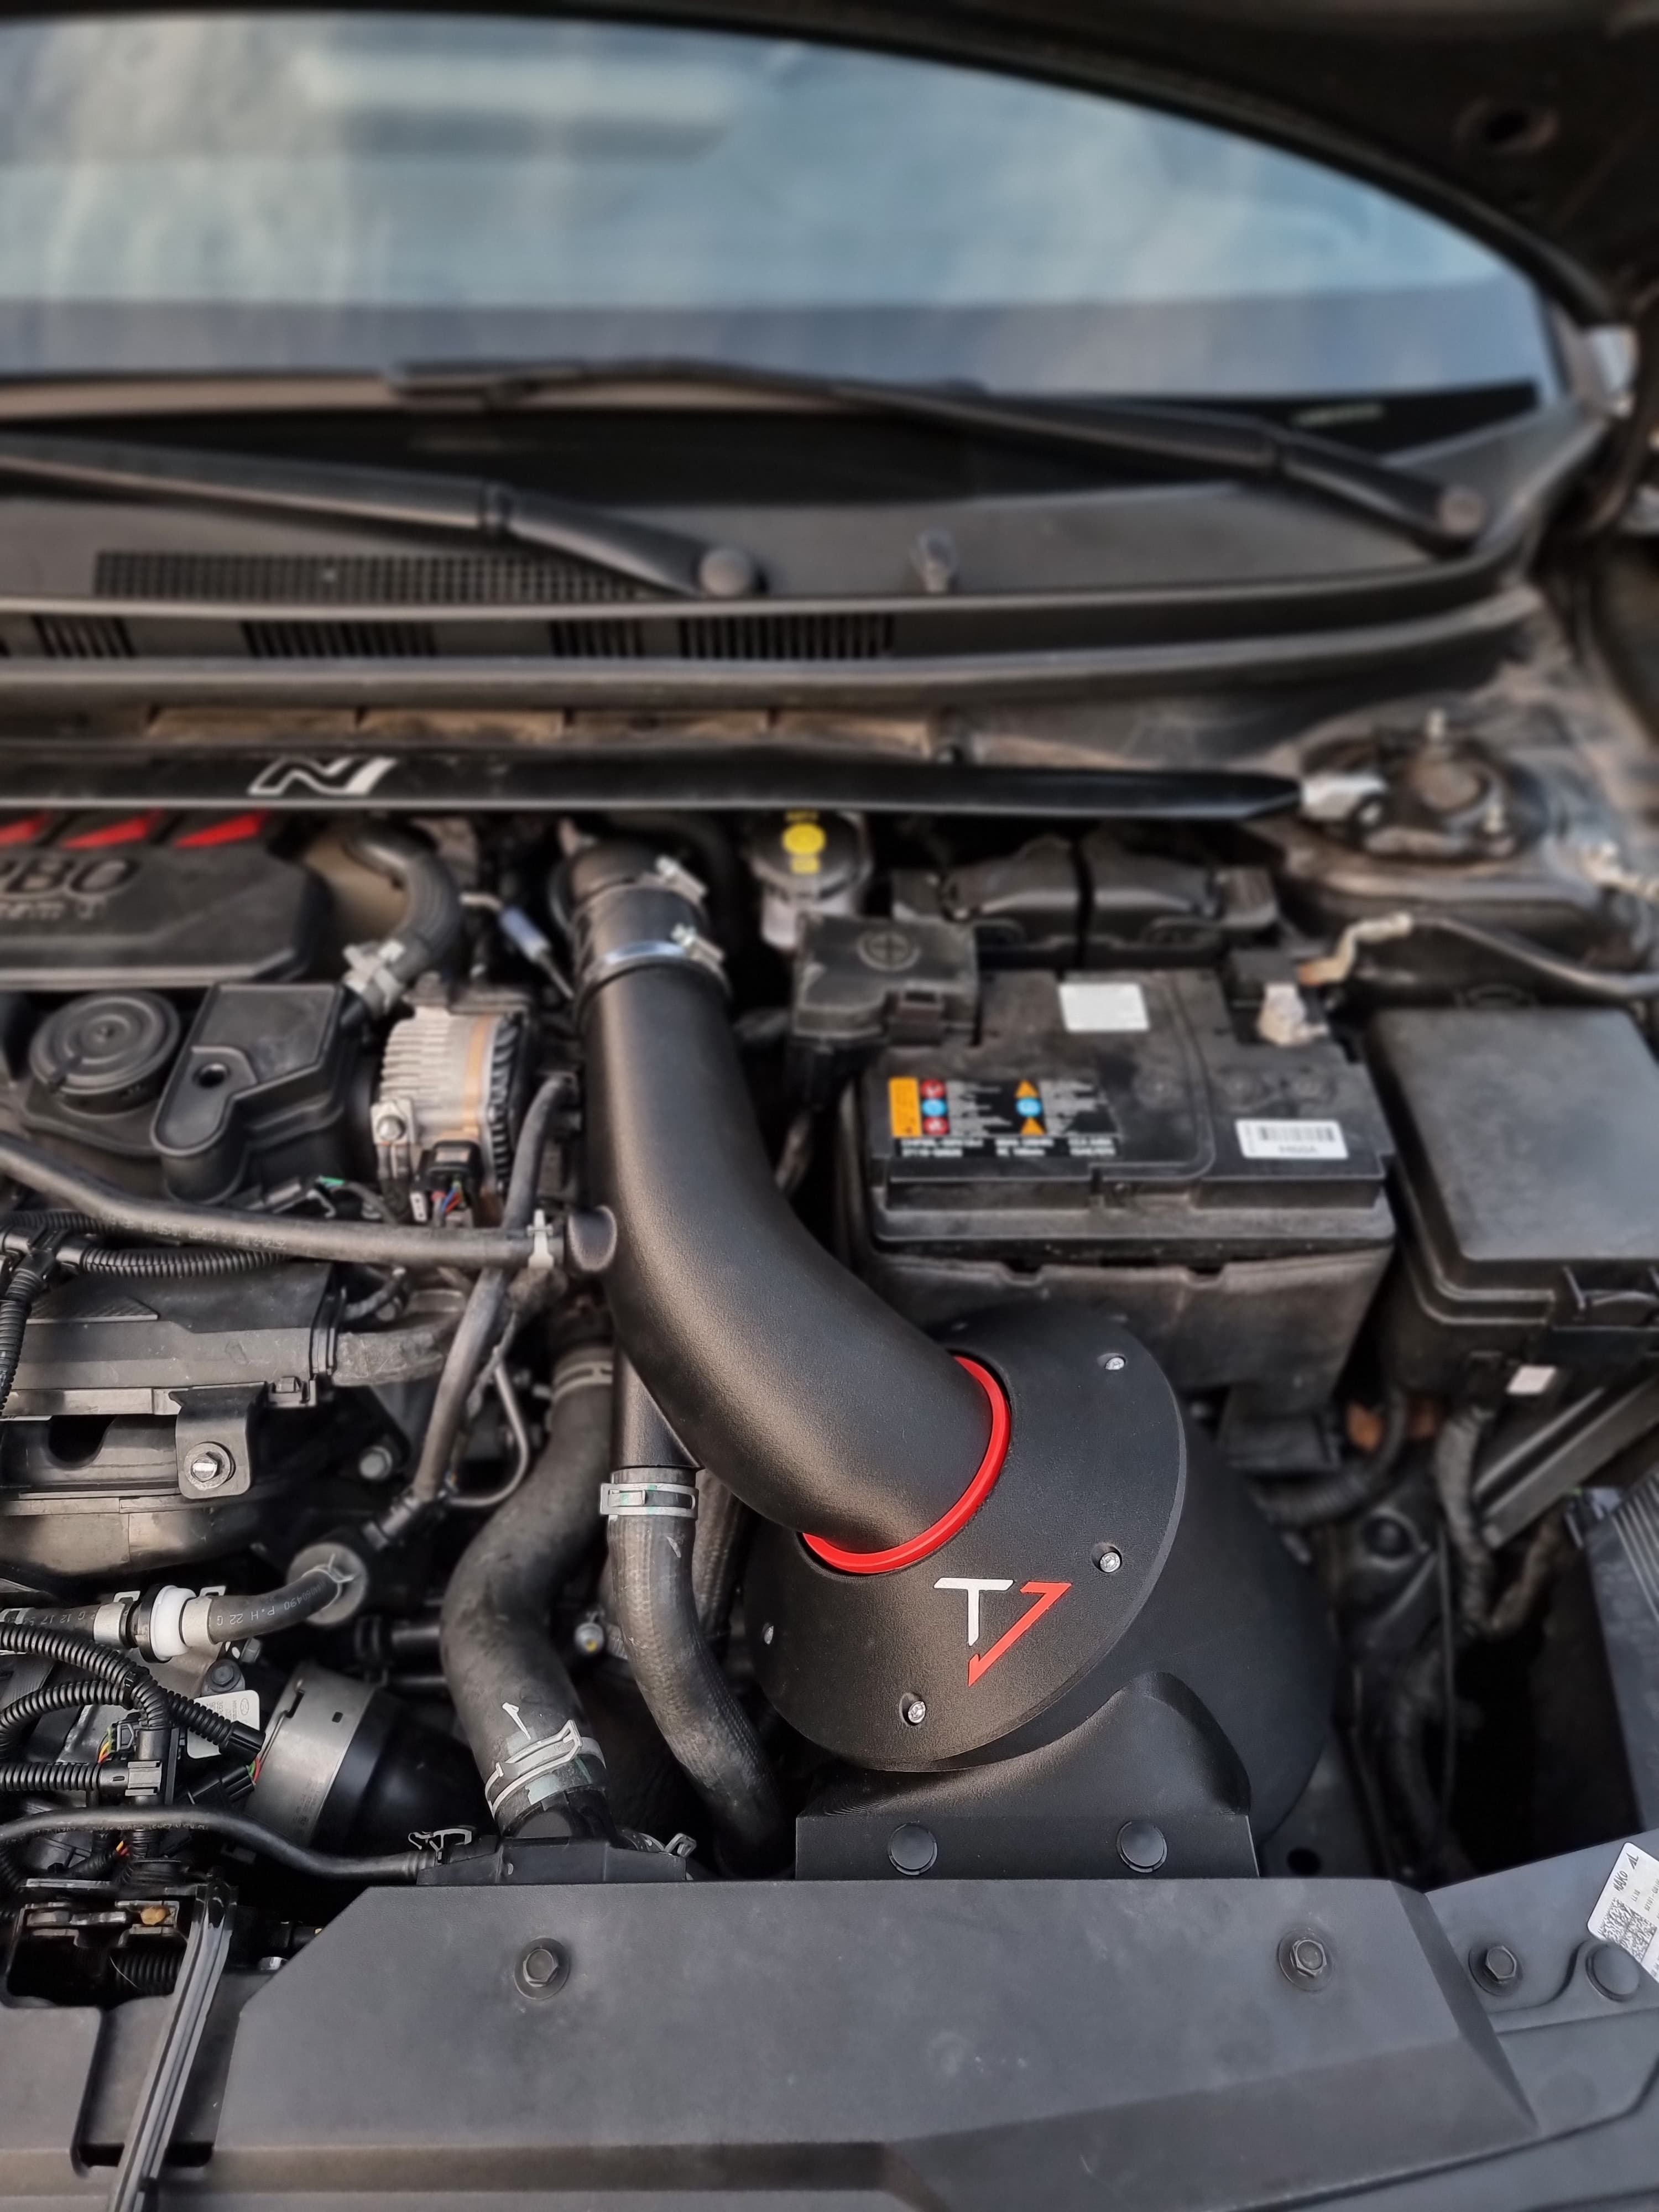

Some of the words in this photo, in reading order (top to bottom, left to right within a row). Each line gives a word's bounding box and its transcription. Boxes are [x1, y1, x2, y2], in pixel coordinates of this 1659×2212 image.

[217, 1615, 223, 1625] G
[229, 1614, 243, 1625] 22
[933, 1577, 1072, 1687] T7
